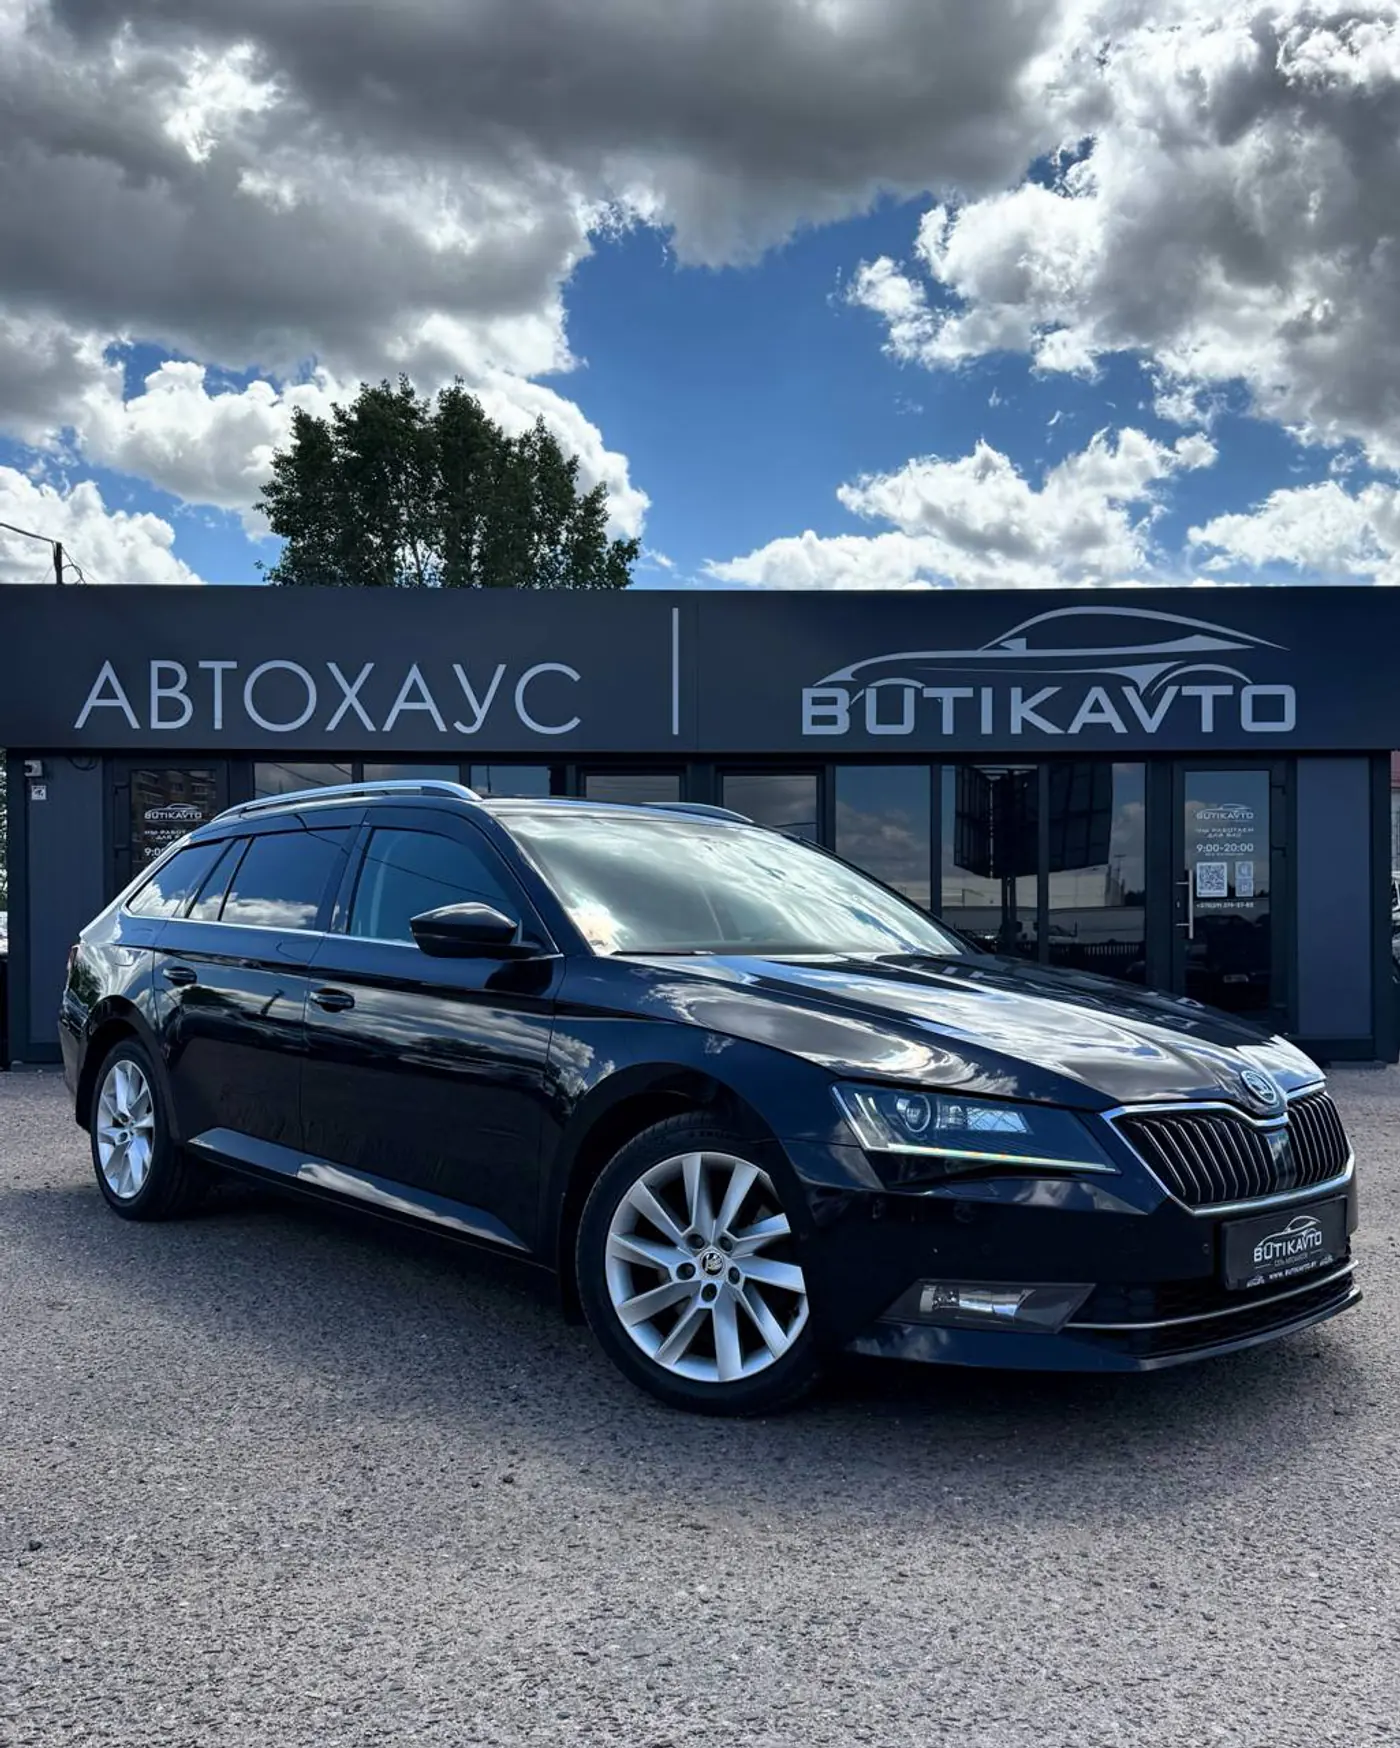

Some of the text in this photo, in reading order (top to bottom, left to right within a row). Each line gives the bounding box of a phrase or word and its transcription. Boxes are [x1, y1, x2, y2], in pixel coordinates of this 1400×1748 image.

[74, 660, 582, 735] АВТОХАУС
[802, 684, 1297, 735] BUTIKAVTO
[144, 811, 202, 820] BUTIKAVTO
[1196, 811, 1254, 820] BUTIKAVTO
[1196, 843, 1254, 852] 9:00-20:00
[1253, 1231, 1322, 1263] BUTIKAVTO
